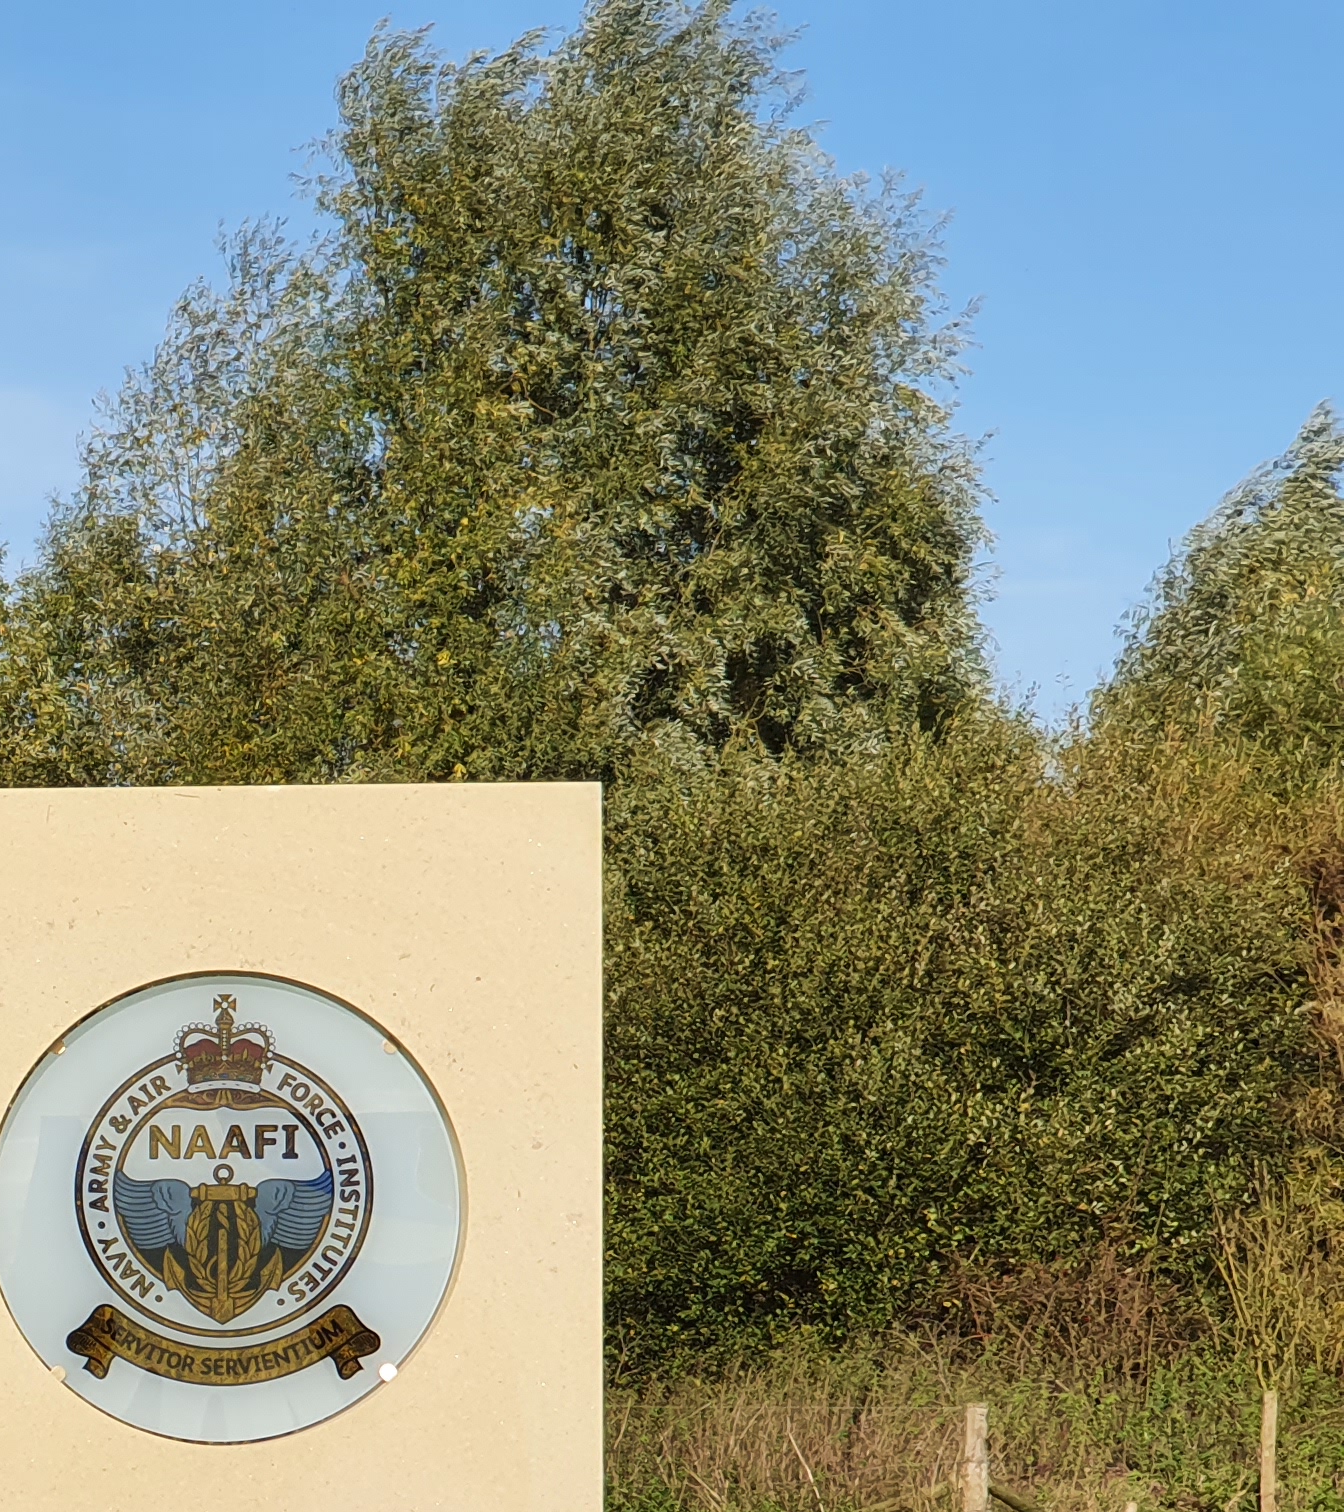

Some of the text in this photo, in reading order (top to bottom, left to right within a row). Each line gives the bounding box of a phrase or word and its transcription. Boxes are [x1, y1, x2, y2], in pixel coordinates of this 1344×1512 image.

[149, 1124, 299, 1159] NAAFI
[88, 1073, 361, 1302] NAVY ARMY & AIR FORCE INSTITUTES
[100, 1318, 345, 1379] SERVITOR SERVIENTIUM
